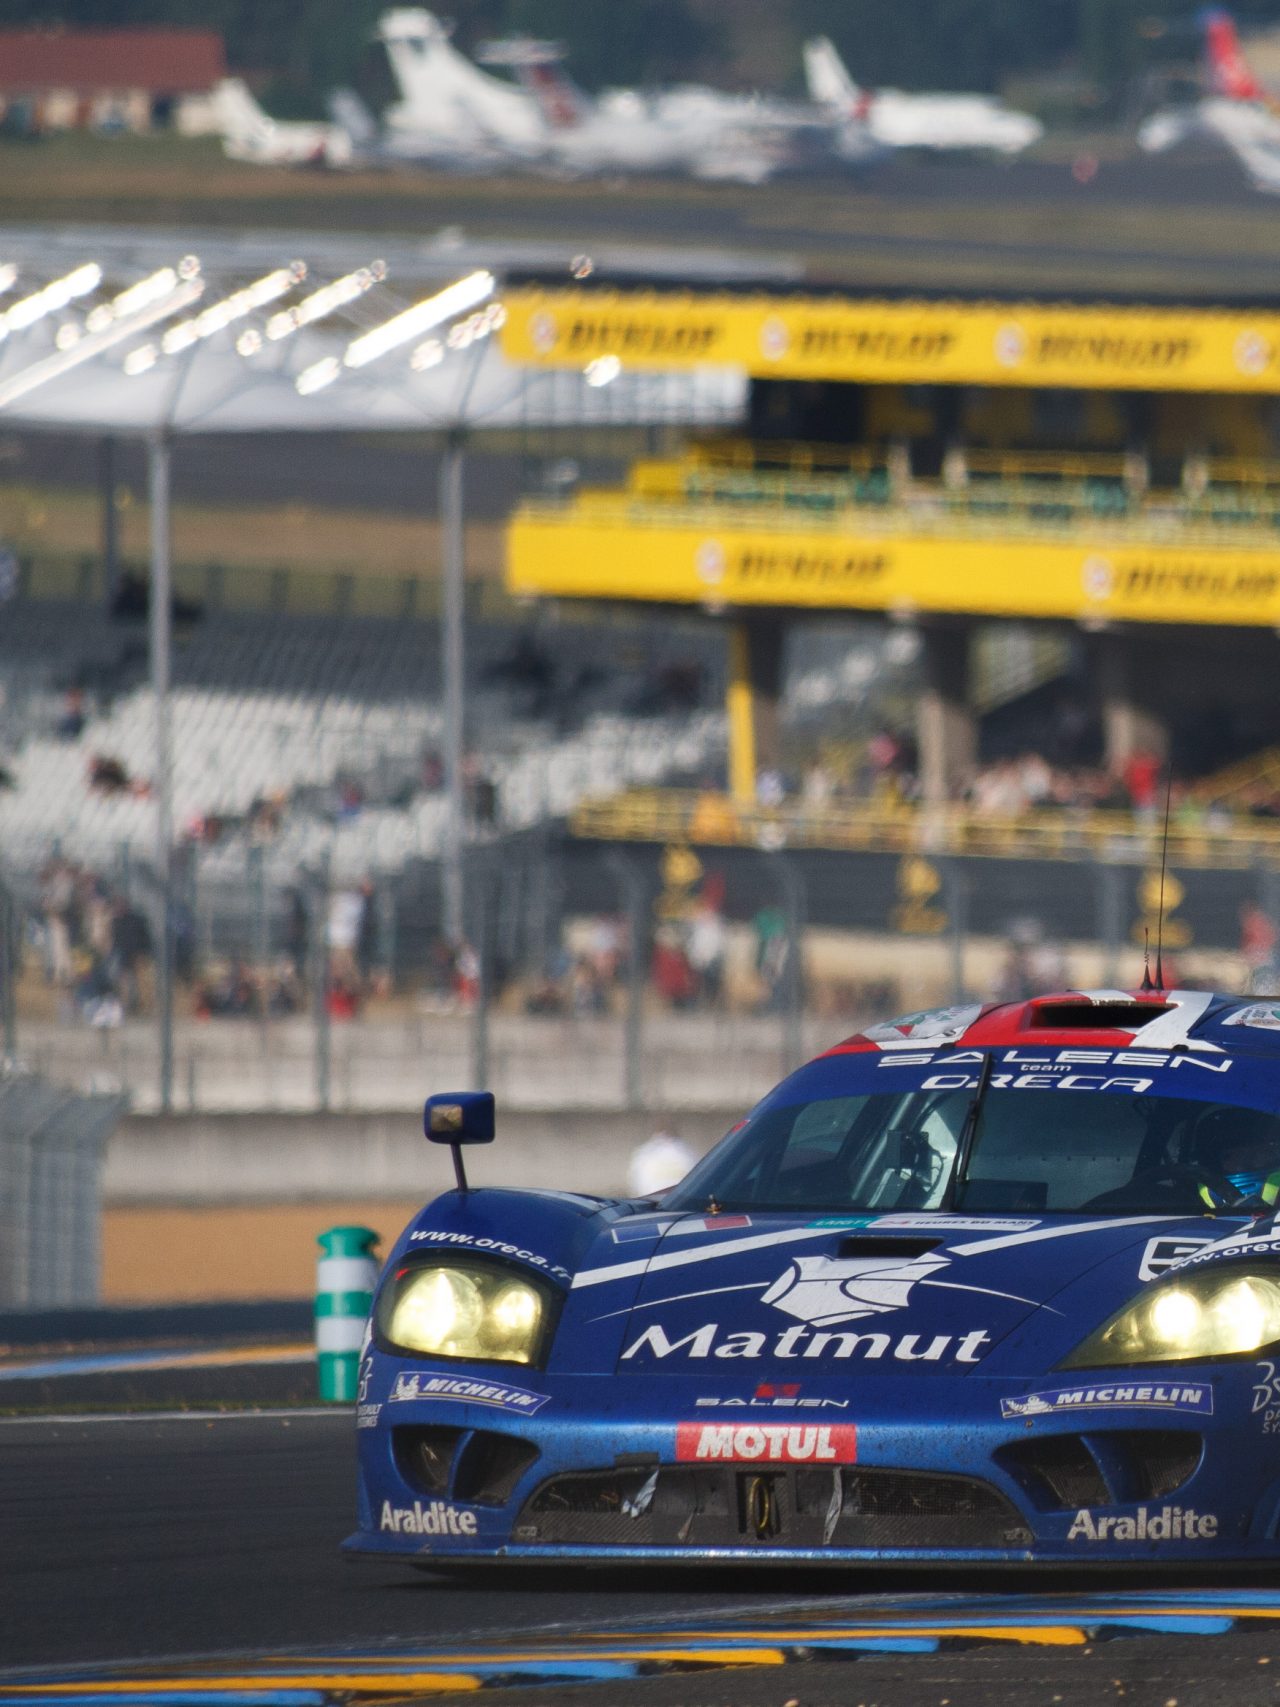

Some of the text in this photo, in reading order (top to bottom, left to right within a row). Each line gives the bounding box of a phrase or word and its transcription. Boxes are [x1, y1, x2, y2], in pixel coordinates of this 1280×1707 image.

[877, 1051, 1233, 1073] SALEEN
[1020, 1063, 1072, 1072] team
[620, 1323, 991, 1363] Matmut
[423, 1378, 540, 1407] MICHELIN
[696, 1397, 850, 1408] SALEEN
[1056, 1386, 1203, 1404] MICHELIN
[696, 1425, 837, 1460] MOTUL
[380, 1501, 478, 1536] Araldite
[1066, 1506, 1219, 1541] Araldite
